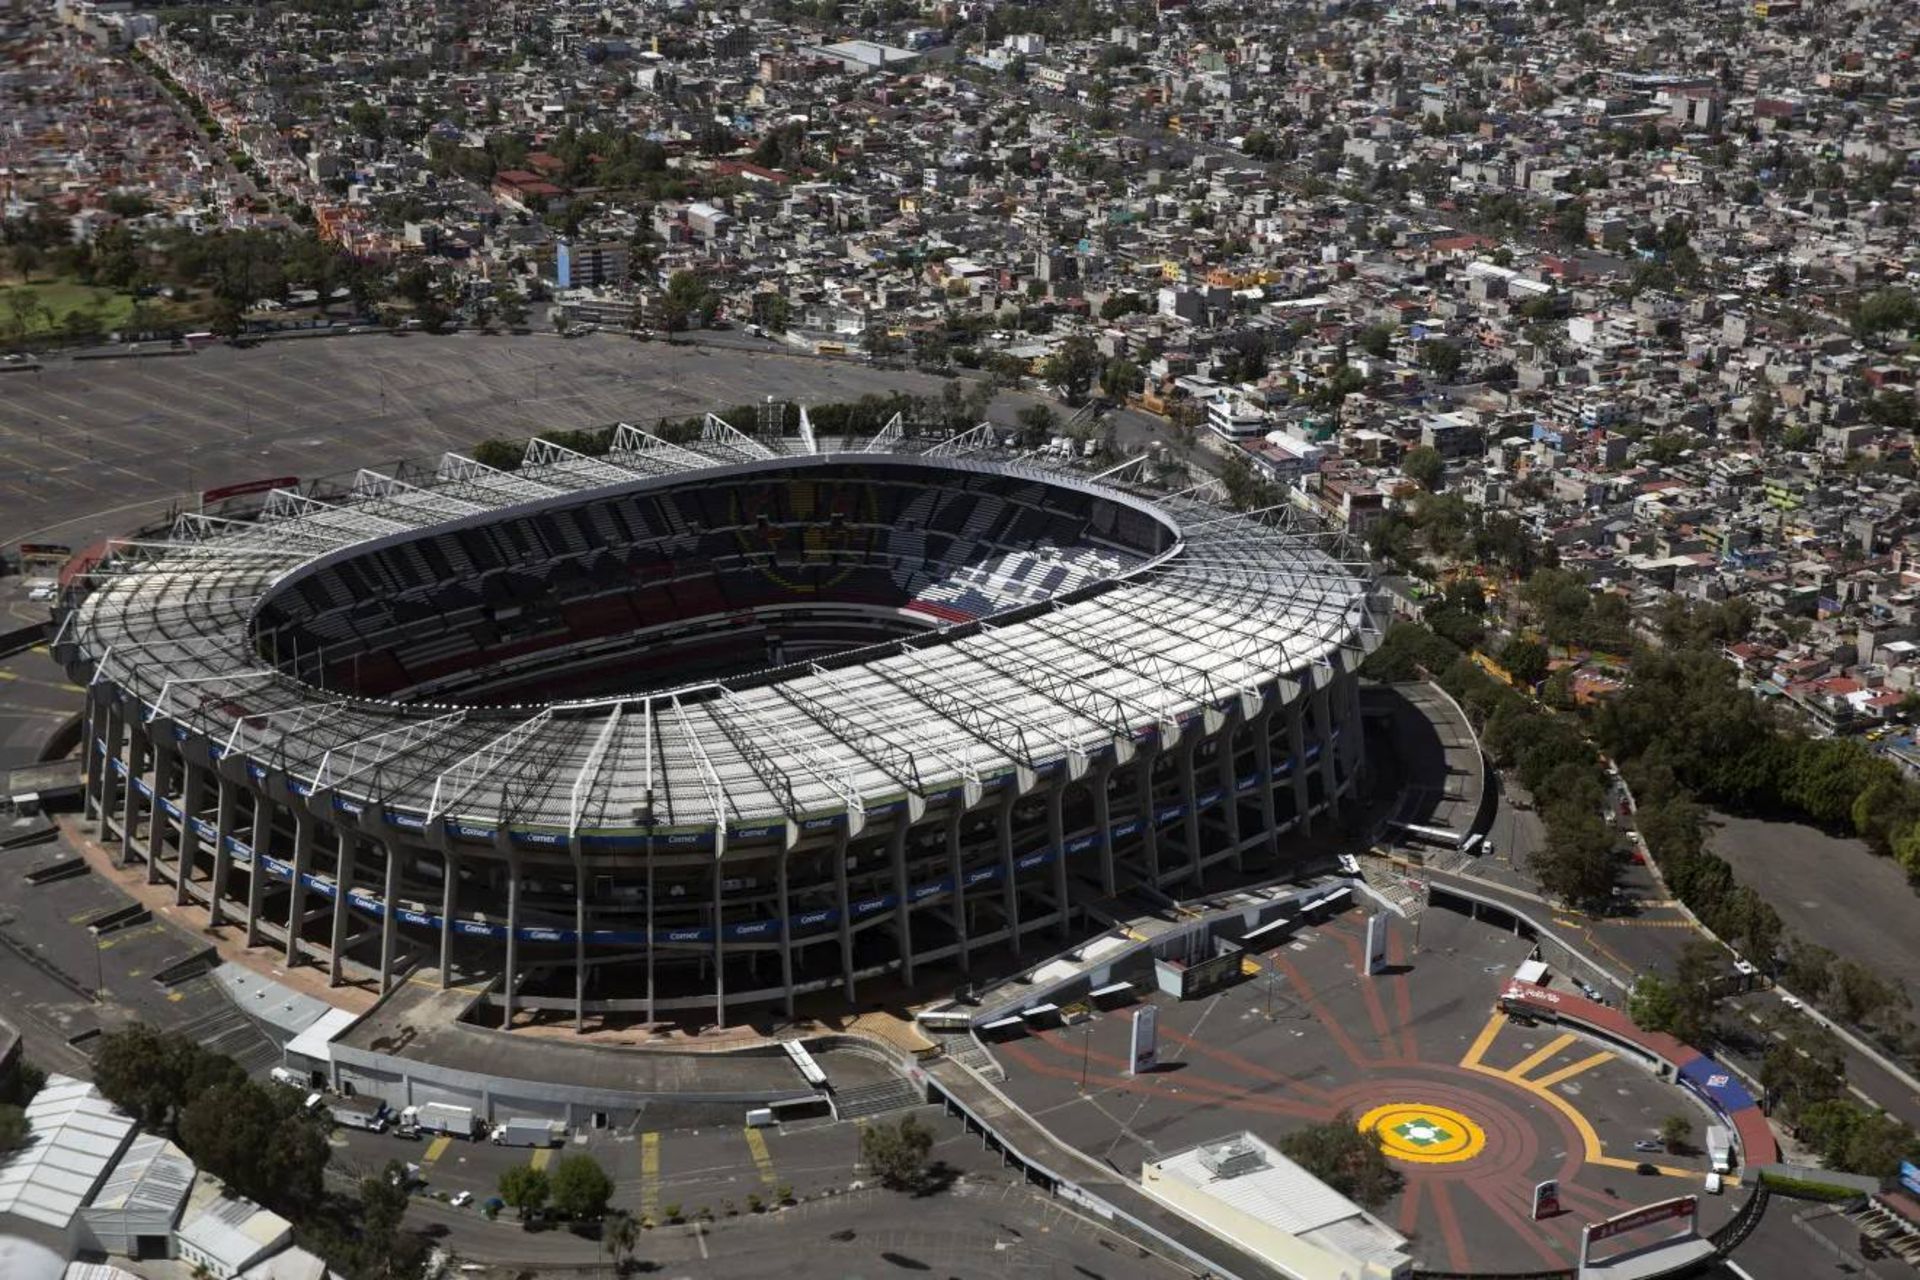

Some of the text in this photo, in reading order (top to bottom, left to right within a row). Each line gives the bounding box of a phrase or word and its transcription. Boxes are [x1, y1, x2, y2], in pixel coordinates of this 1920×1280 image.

[460, 827, 490, 837] Comex
[738, 828, 768, 838] Comex
[527, 834, 557, 843] Comex
[668, 834, 698, 843] Comex
[915, 883, 942, 896] Comex
[858, 899, 886, 911] Comex
[800, 912, 828, 924] Comex
[464, 924, 492, 935] Comex
[736, 923, 767, 934] Comex
[530, 931, 561, 940] Comex
[669, 931, 700, 940] Comex
